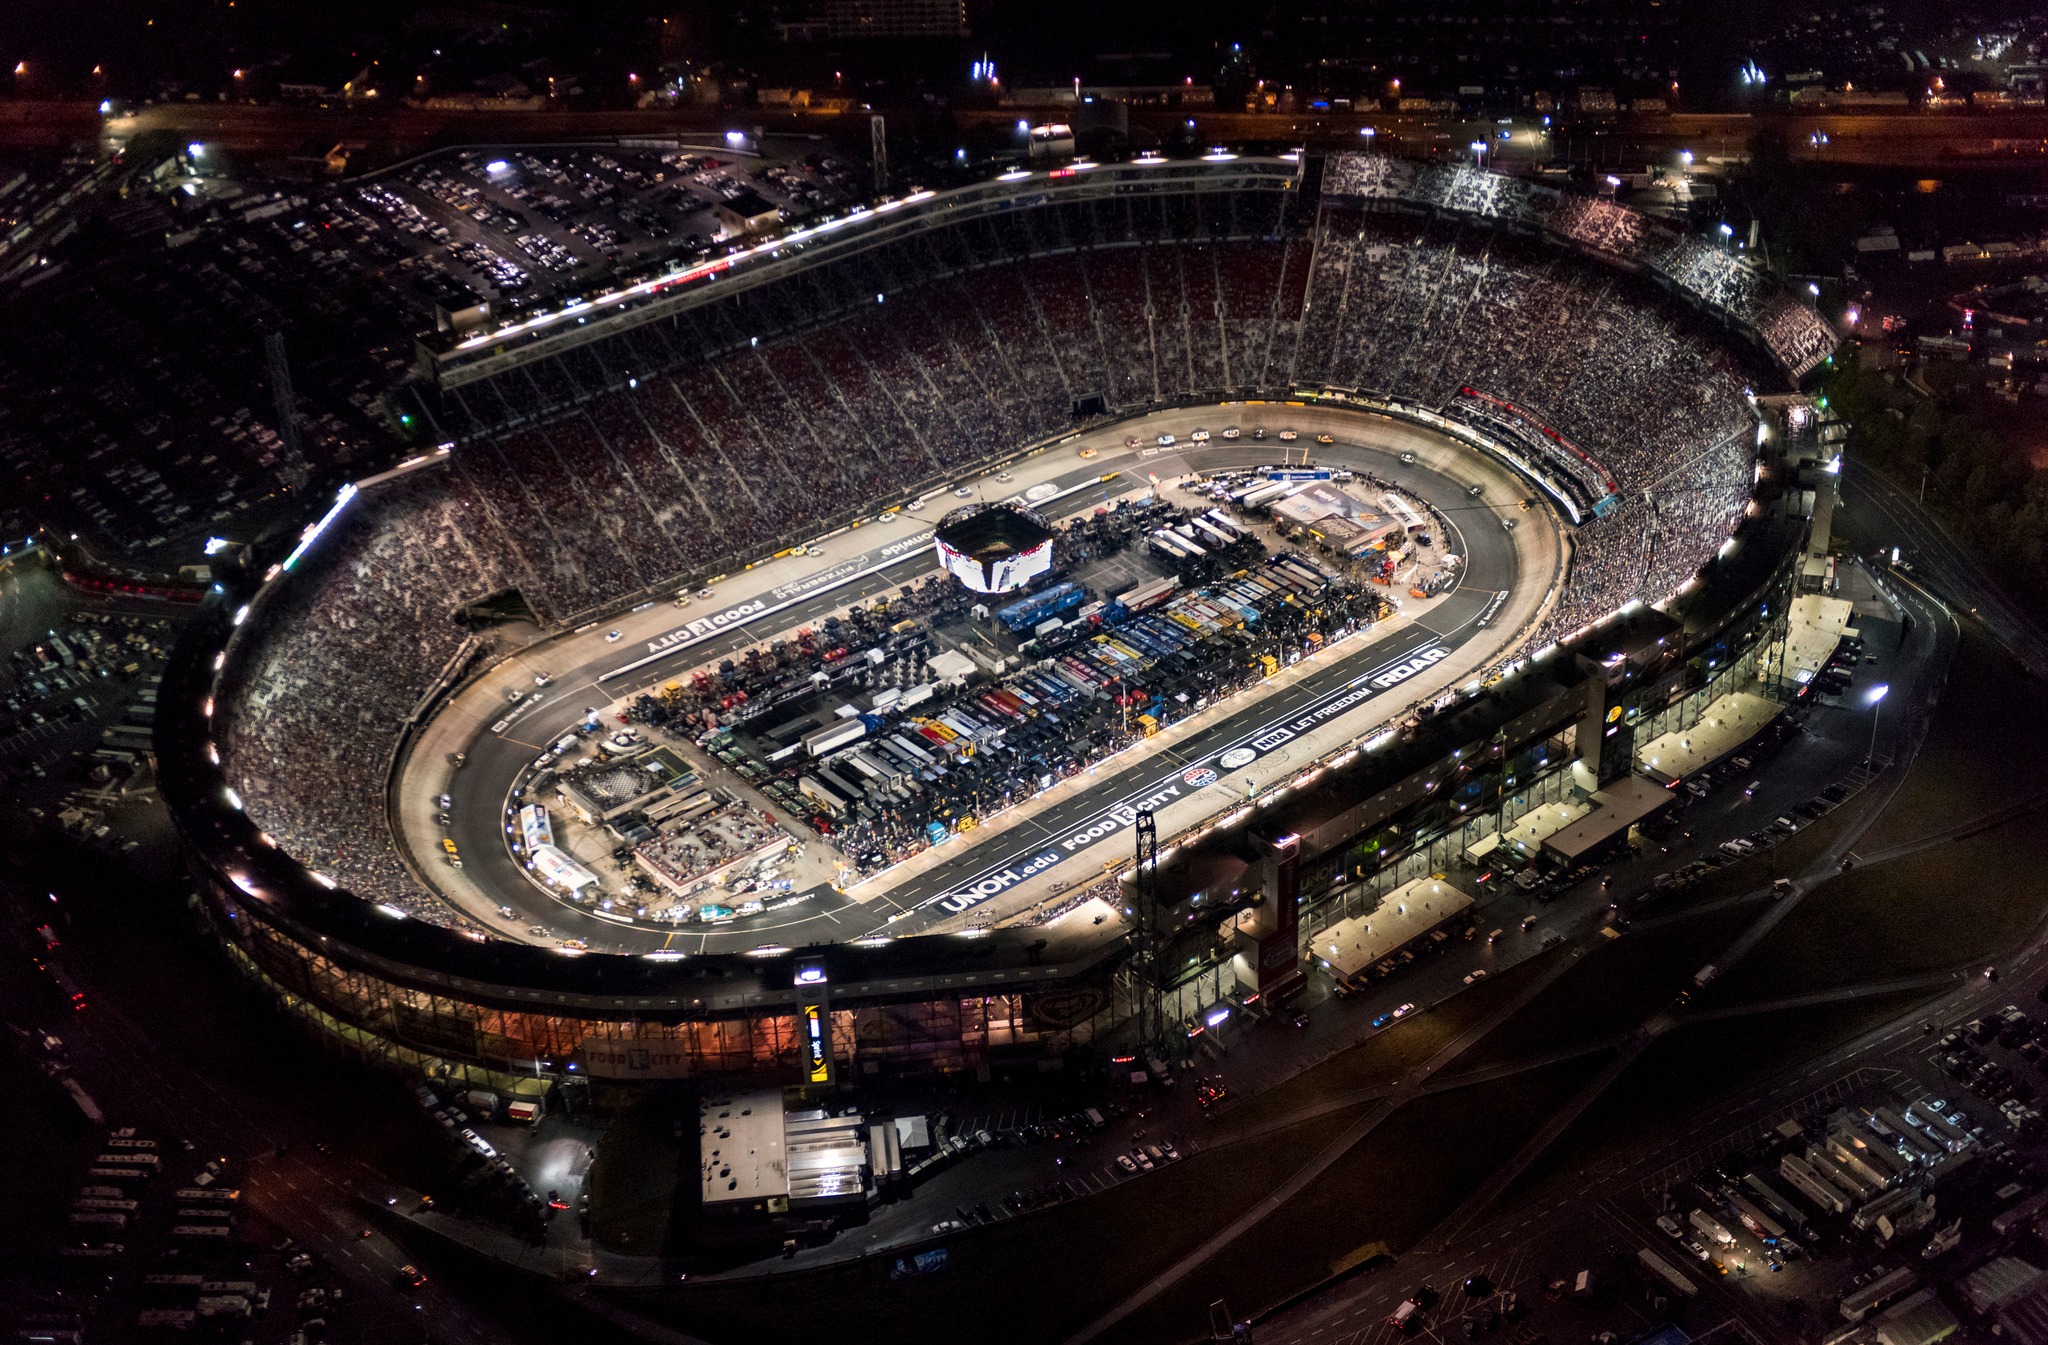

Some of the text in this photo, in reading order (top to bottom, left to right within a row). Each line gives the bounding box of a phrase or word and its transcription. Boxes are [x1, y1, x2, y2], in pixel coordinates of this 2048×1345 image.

[776, 565, 855, 599] FITZGERALD
[647, 599, 766, 653] FOOD CITY
[1256, 649, 1450, 748] NRA LET FREEDOM ROAR
[1061, 785, 1181, 851] FOOD CITY
[766, 893, 815, 911] FOOD CITY
[940, 852, 1060, 912] UNOH.edu
[589, 1051, 682, 1066] FOOD CITY
[811, 1040, 822, 1059] Sprint
